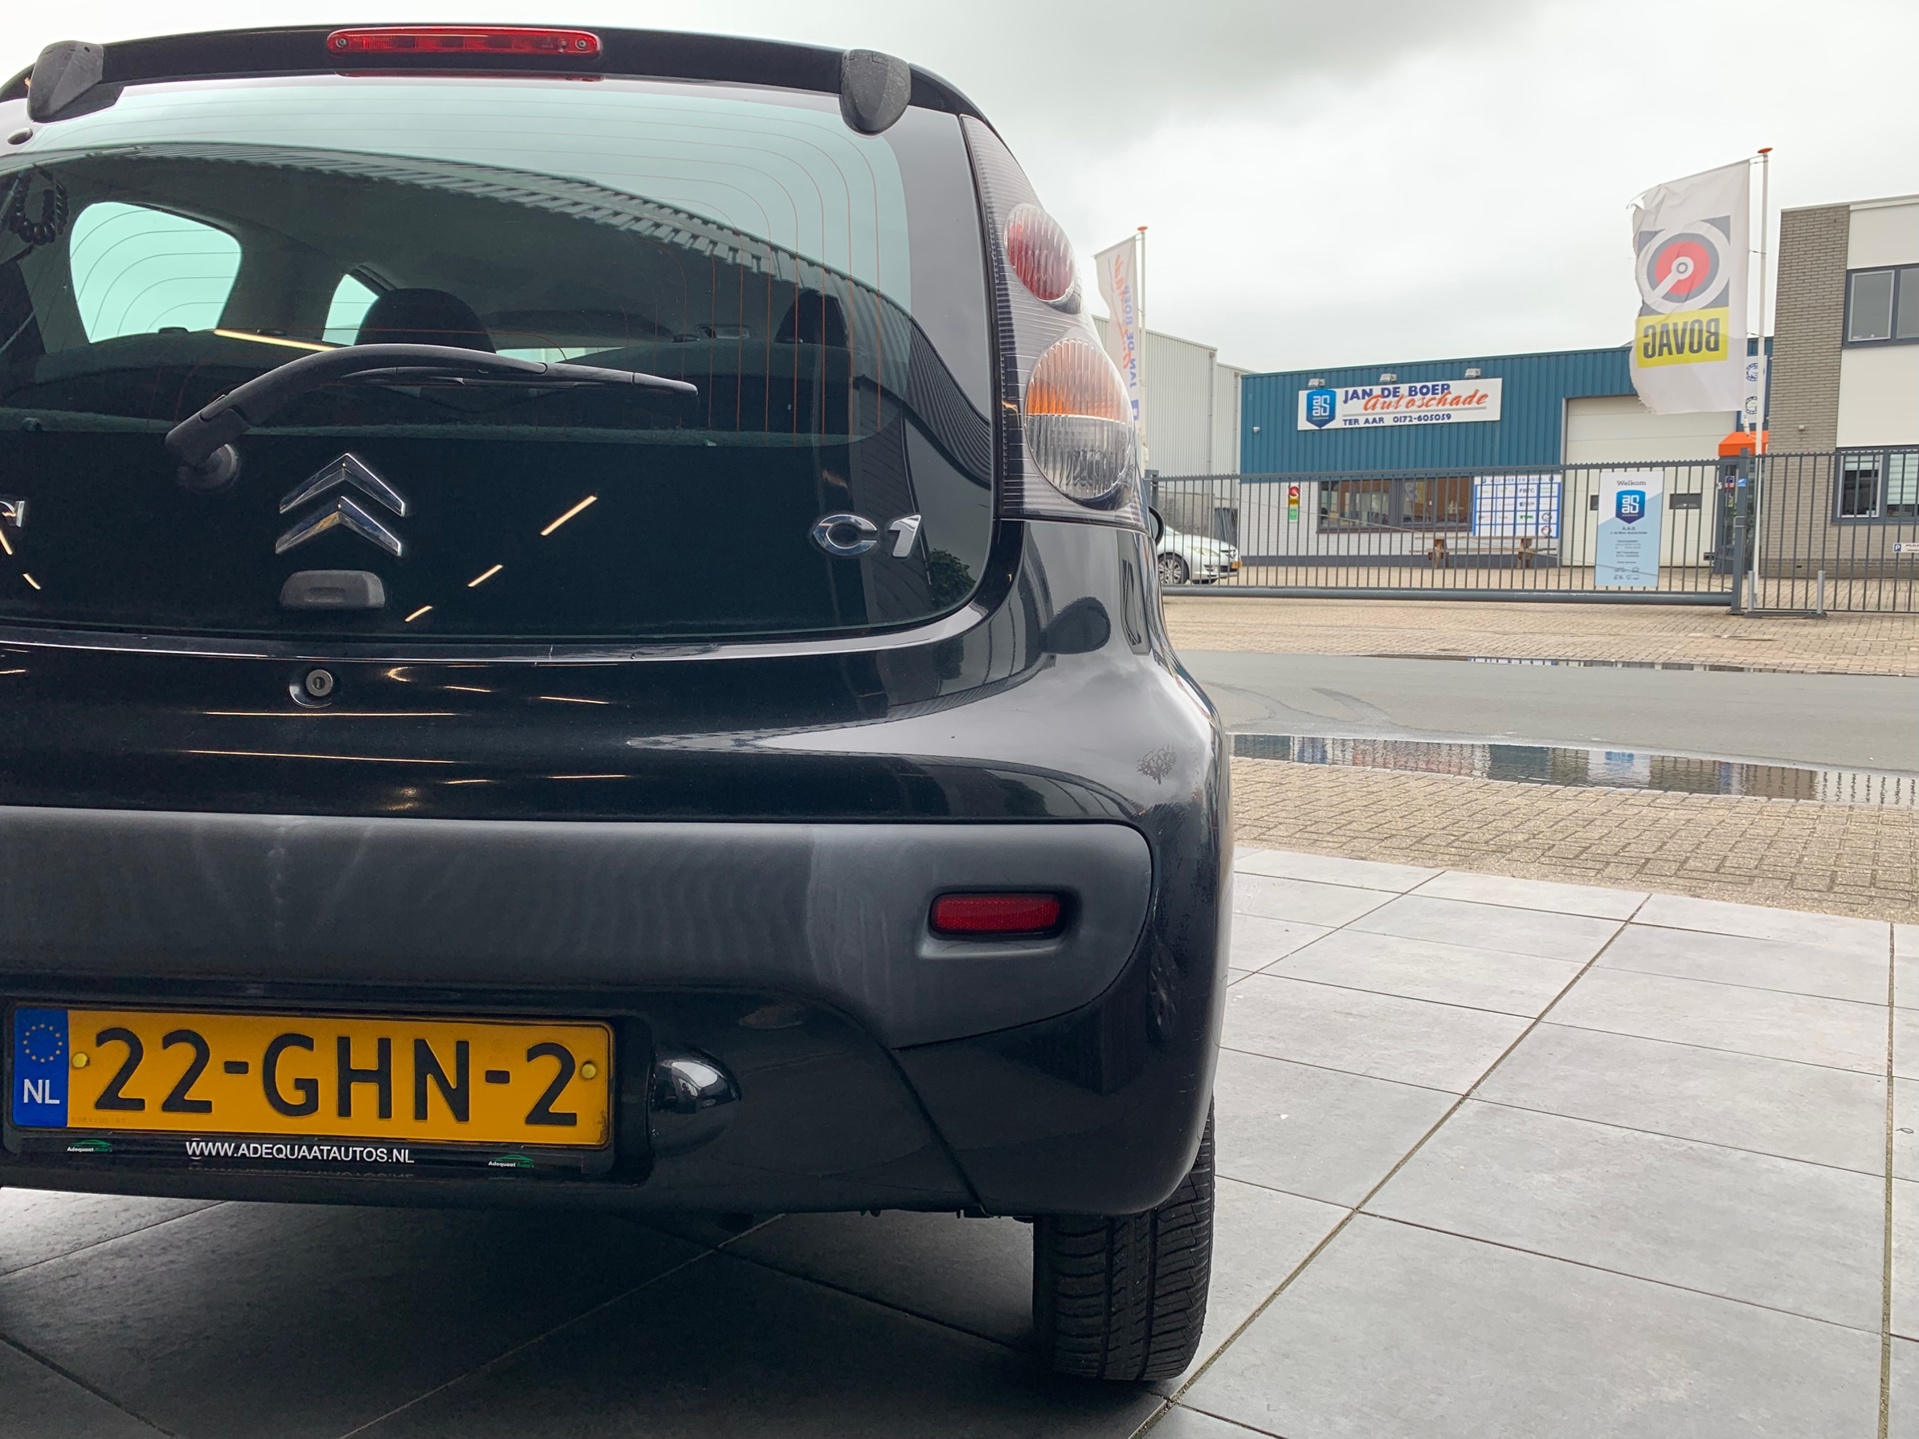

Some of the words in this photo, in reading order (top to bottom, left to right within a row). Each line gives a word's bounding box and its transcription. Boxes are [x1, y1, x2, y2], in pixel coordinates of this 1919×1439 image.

[1343, 388, 1373, 404] JAN
[1381, 386, 1401, 398] DE
[1343, 417, 1360, 426] TER
[1363, 416, 1385, 425] AAR
[1393, 413, 1452, 423] 0172-605059
[813, 513, 921, 558] C1
[94, 1028, 579, 1127] 22-GHN-2
[22, 1078, 60, 1105] NL
[185, 1140, 415, 1164] WWW.ADEQUAATAUTOS.NL
